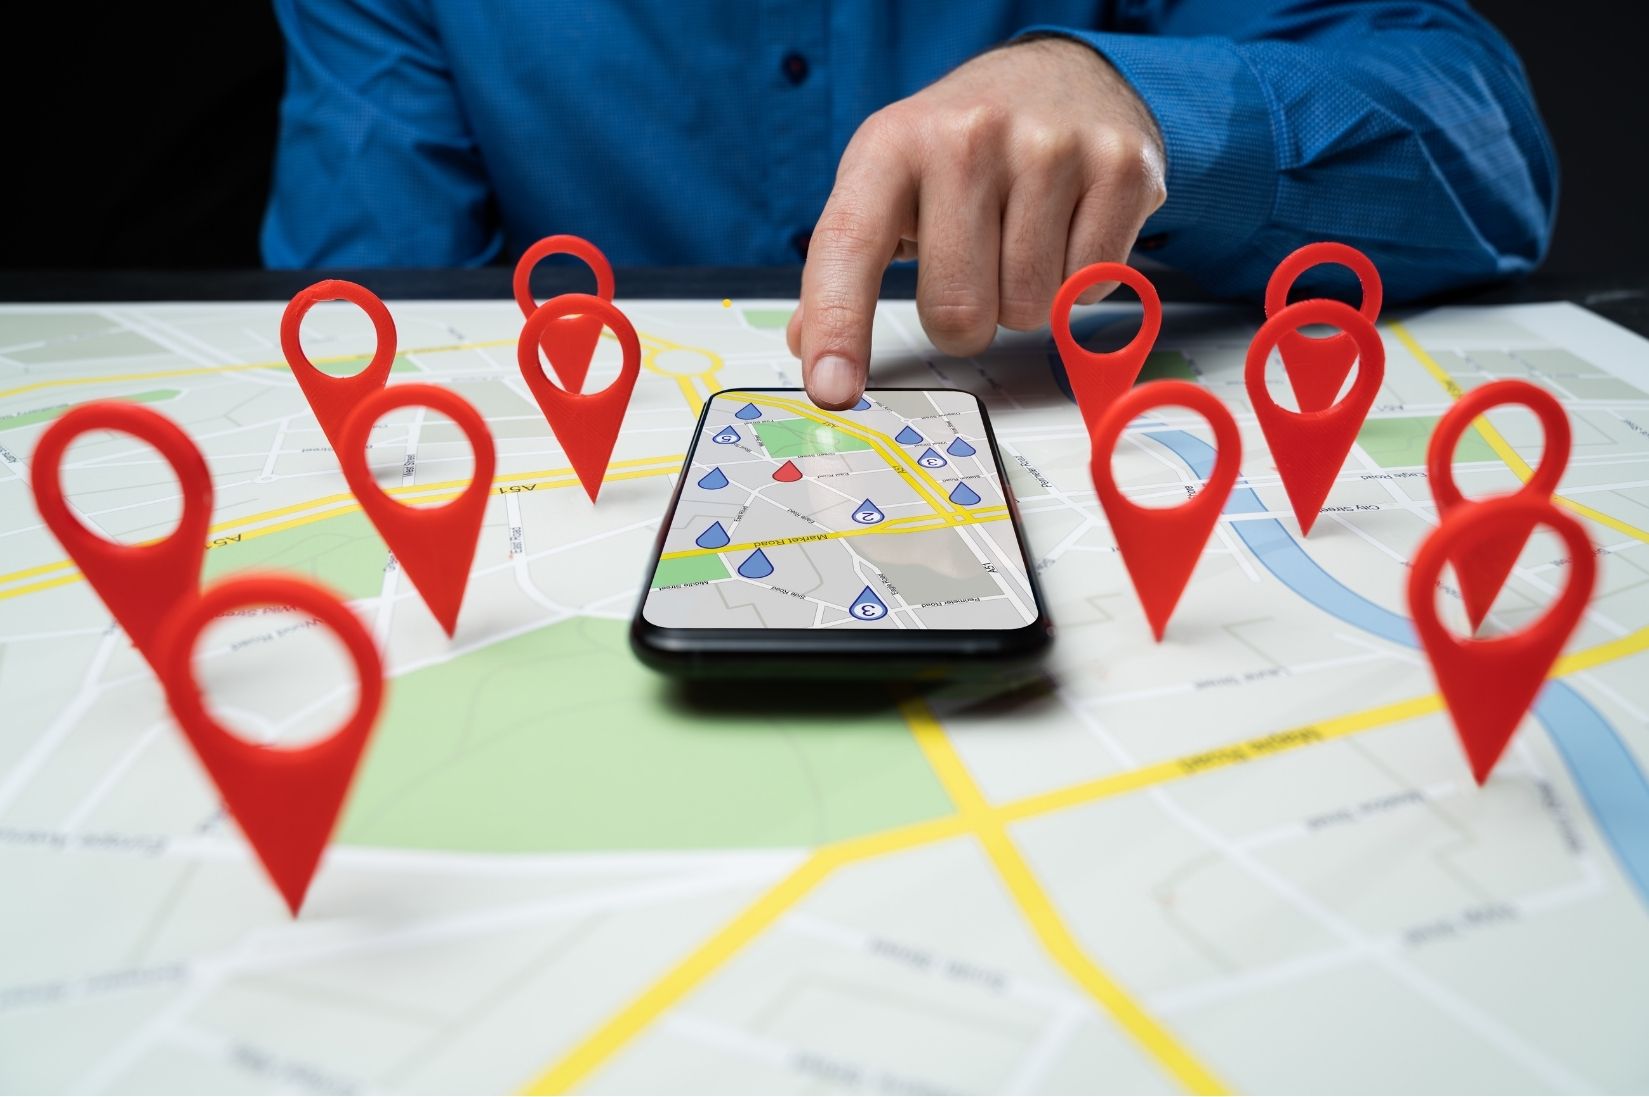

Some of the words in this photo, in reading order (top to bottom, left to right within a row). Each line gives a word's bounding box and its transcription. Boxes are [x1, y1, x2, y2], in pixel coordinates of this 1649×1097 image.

[721, 435, 732, 443] 5
[926, 459, 939, 467] 3
[499, 484, 537, 495] A51
[861, 512, 875, 522] 2
[788, 534, 828, 543] Market
[753, 539, 786, 548] Road
[981, 562, 998, 573] A51
[769, 586, 790, 595] Road
[861, 604, 876, 617] 3
